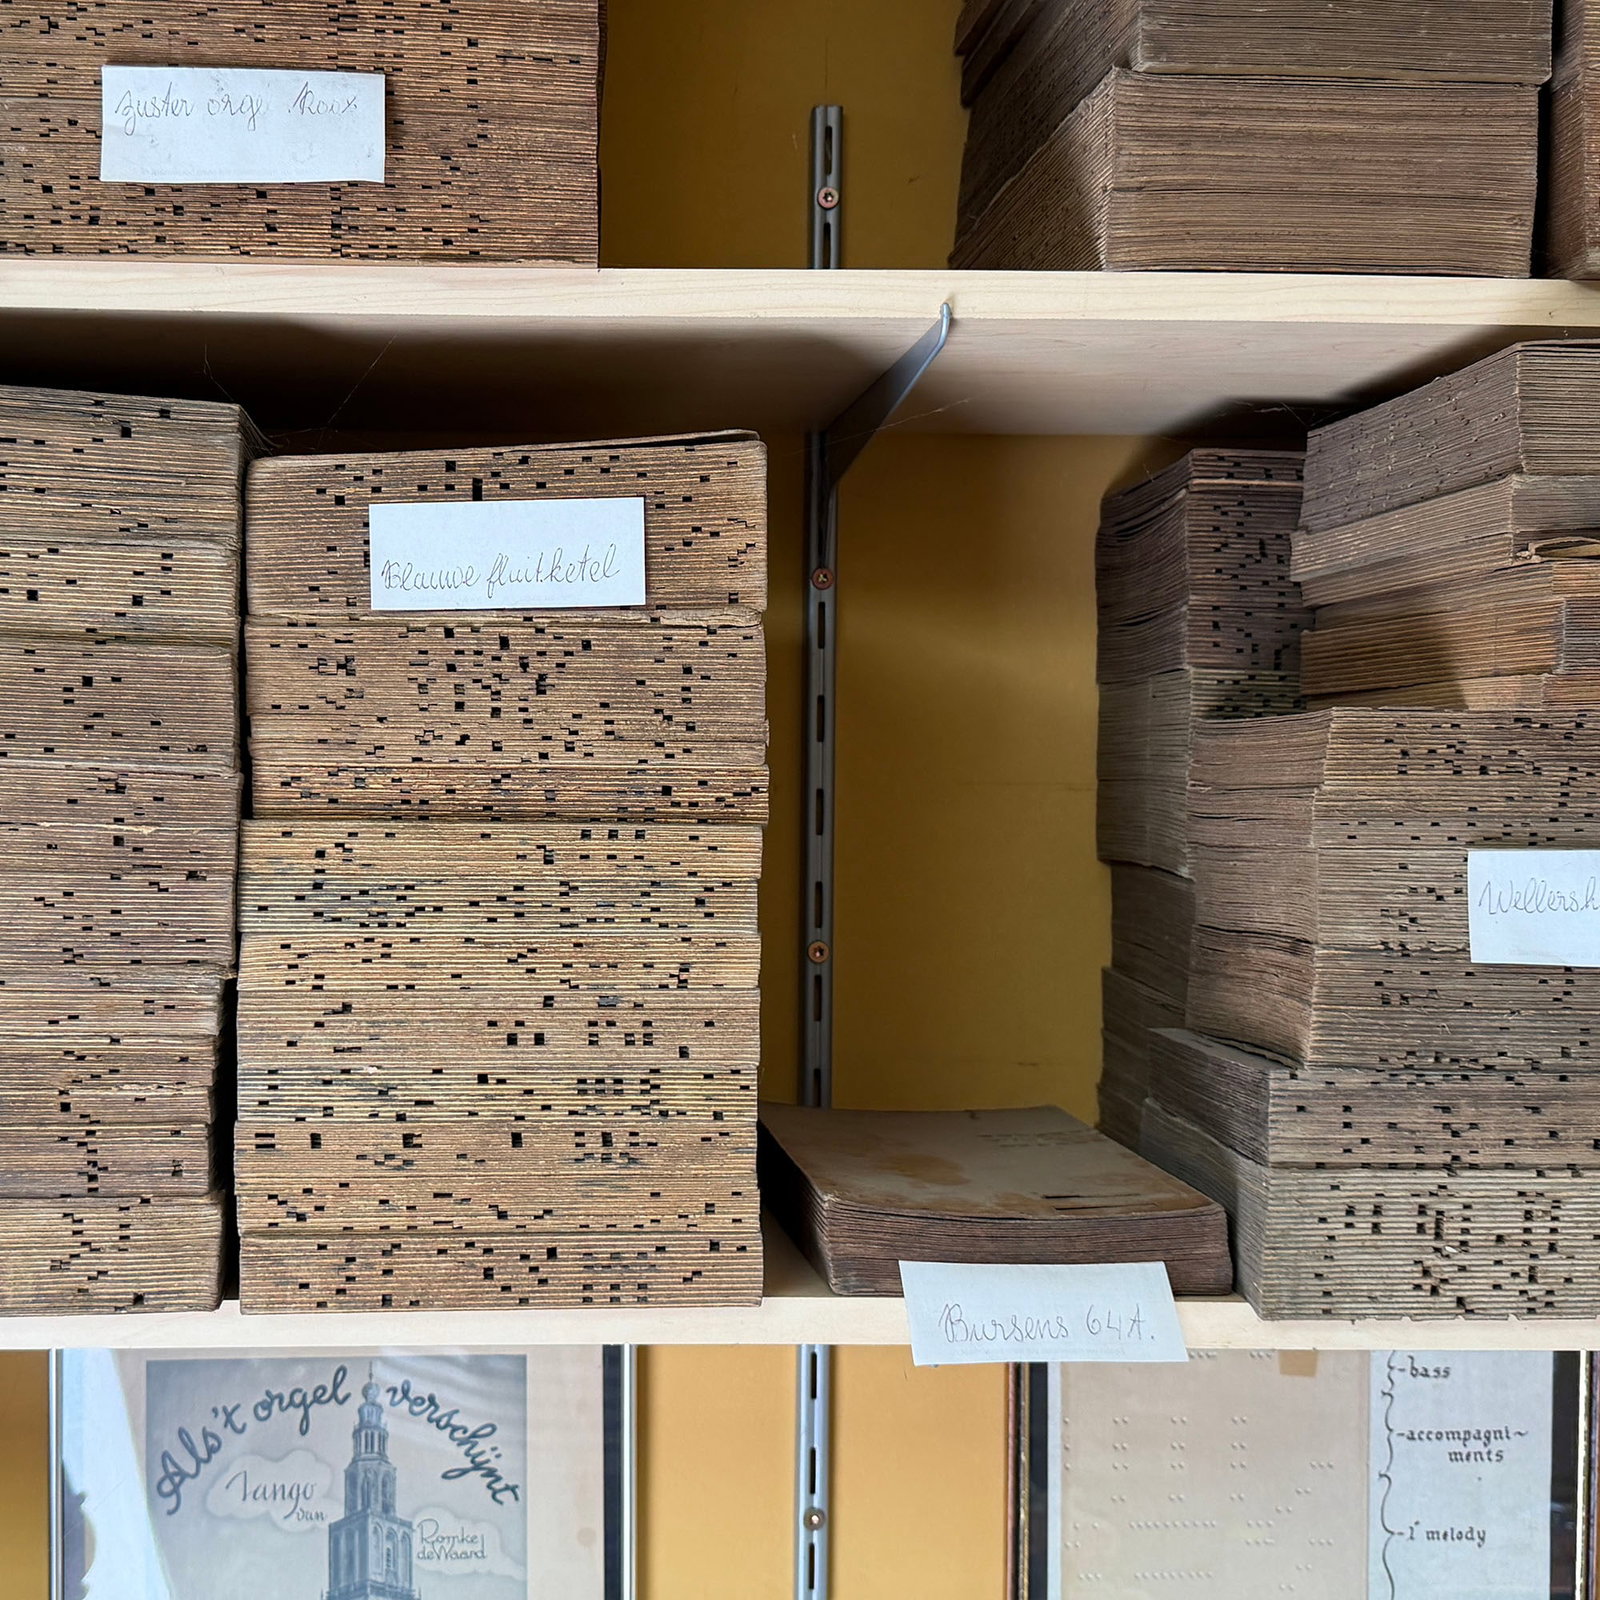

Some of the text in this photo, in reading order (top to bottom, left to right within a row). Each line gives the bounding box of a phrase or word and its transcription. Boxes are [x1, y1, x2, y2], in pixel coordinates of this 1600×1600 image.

[938, 1303, 1069, 1343] Bursens
[1408, 1355, 1451, 1379] bass
[253, 1365, 351, 1436] orgel
[1448, 1449, 1504, 1463] ments
[225, 1470, 316, 1519] Tango
[297, 1508, 326, 1521] van
[417, 1518, 478, 1544] Romke
[1425, 1526, 1486, 1548] melody
